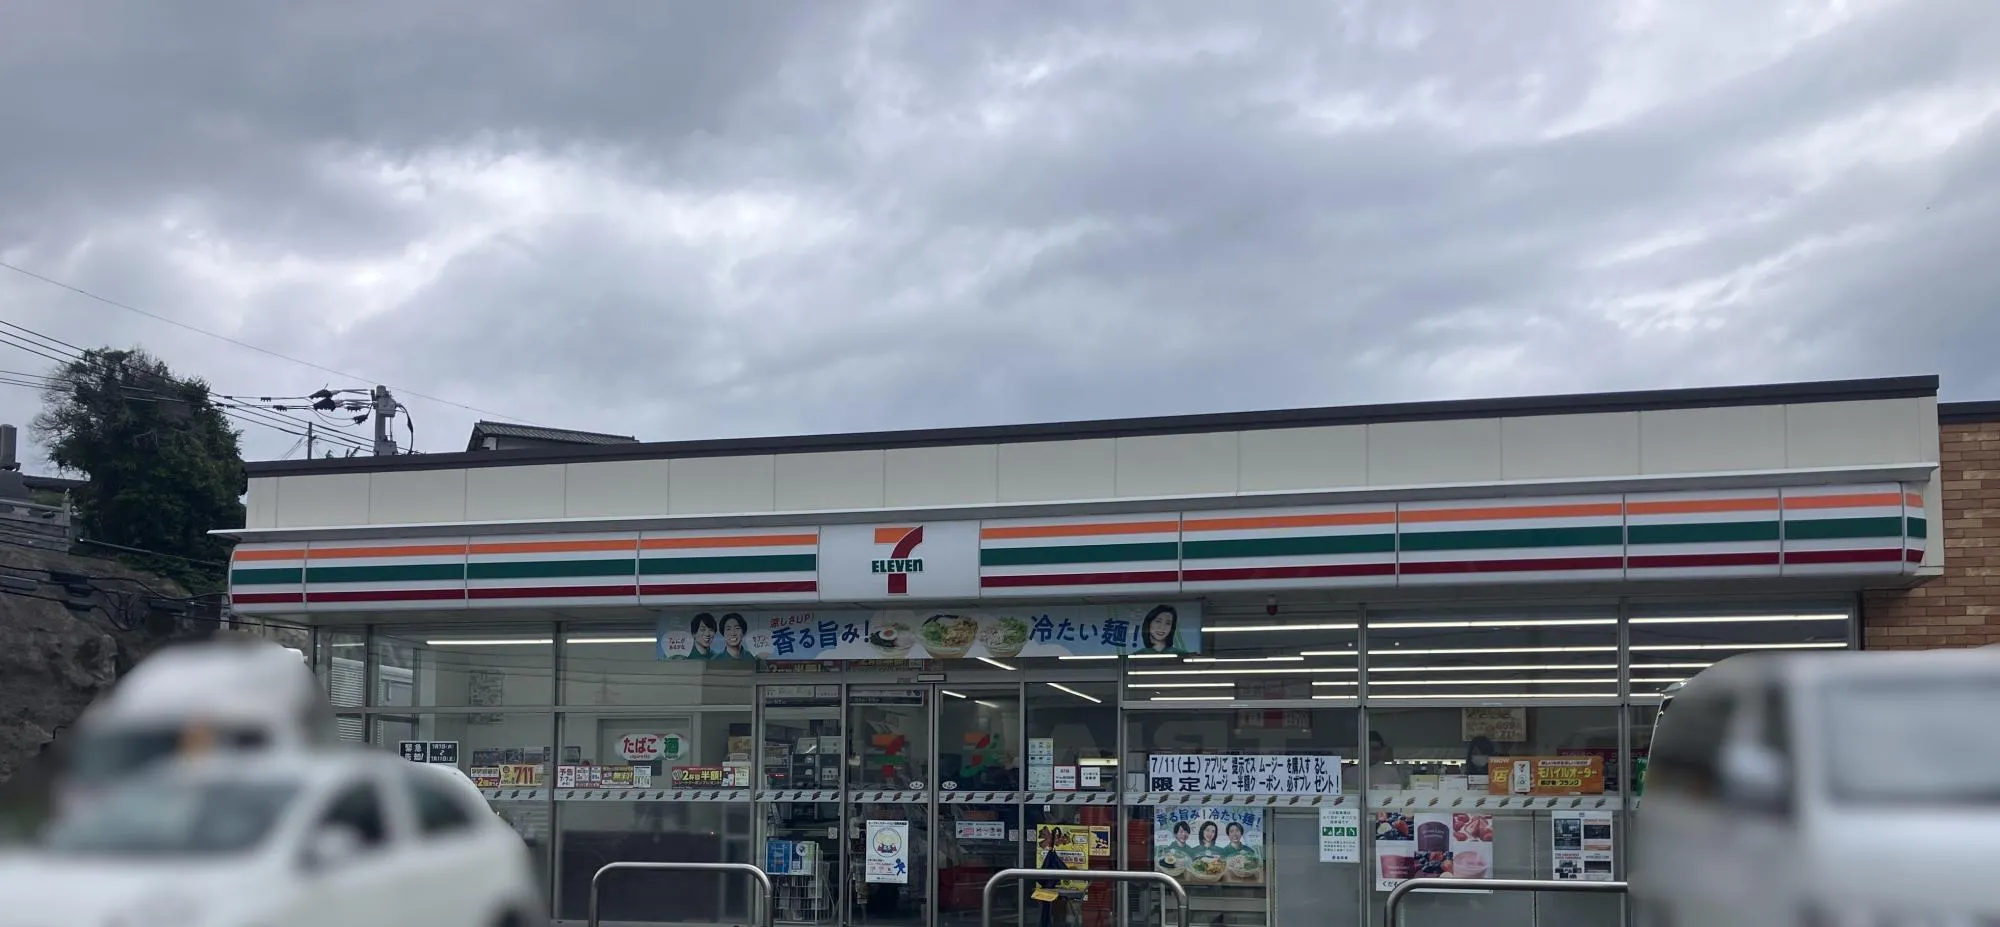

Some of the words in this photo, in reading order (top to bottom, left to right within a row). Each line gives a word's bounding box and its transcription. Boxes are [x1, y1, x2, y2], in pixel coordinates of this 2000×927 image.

[771, 620, 870, 656] 香る旨み!
[1029, 613, 1140, 648] 冷たい麺!
[623, 737, 657, 753] たばこ
[664, 738, 679, 753] 酒
[1151, 756, 1200, 774] 7/11(土)
[514, 766, 534, 784] 711
[1151, 776, 1200, 792] 限定
